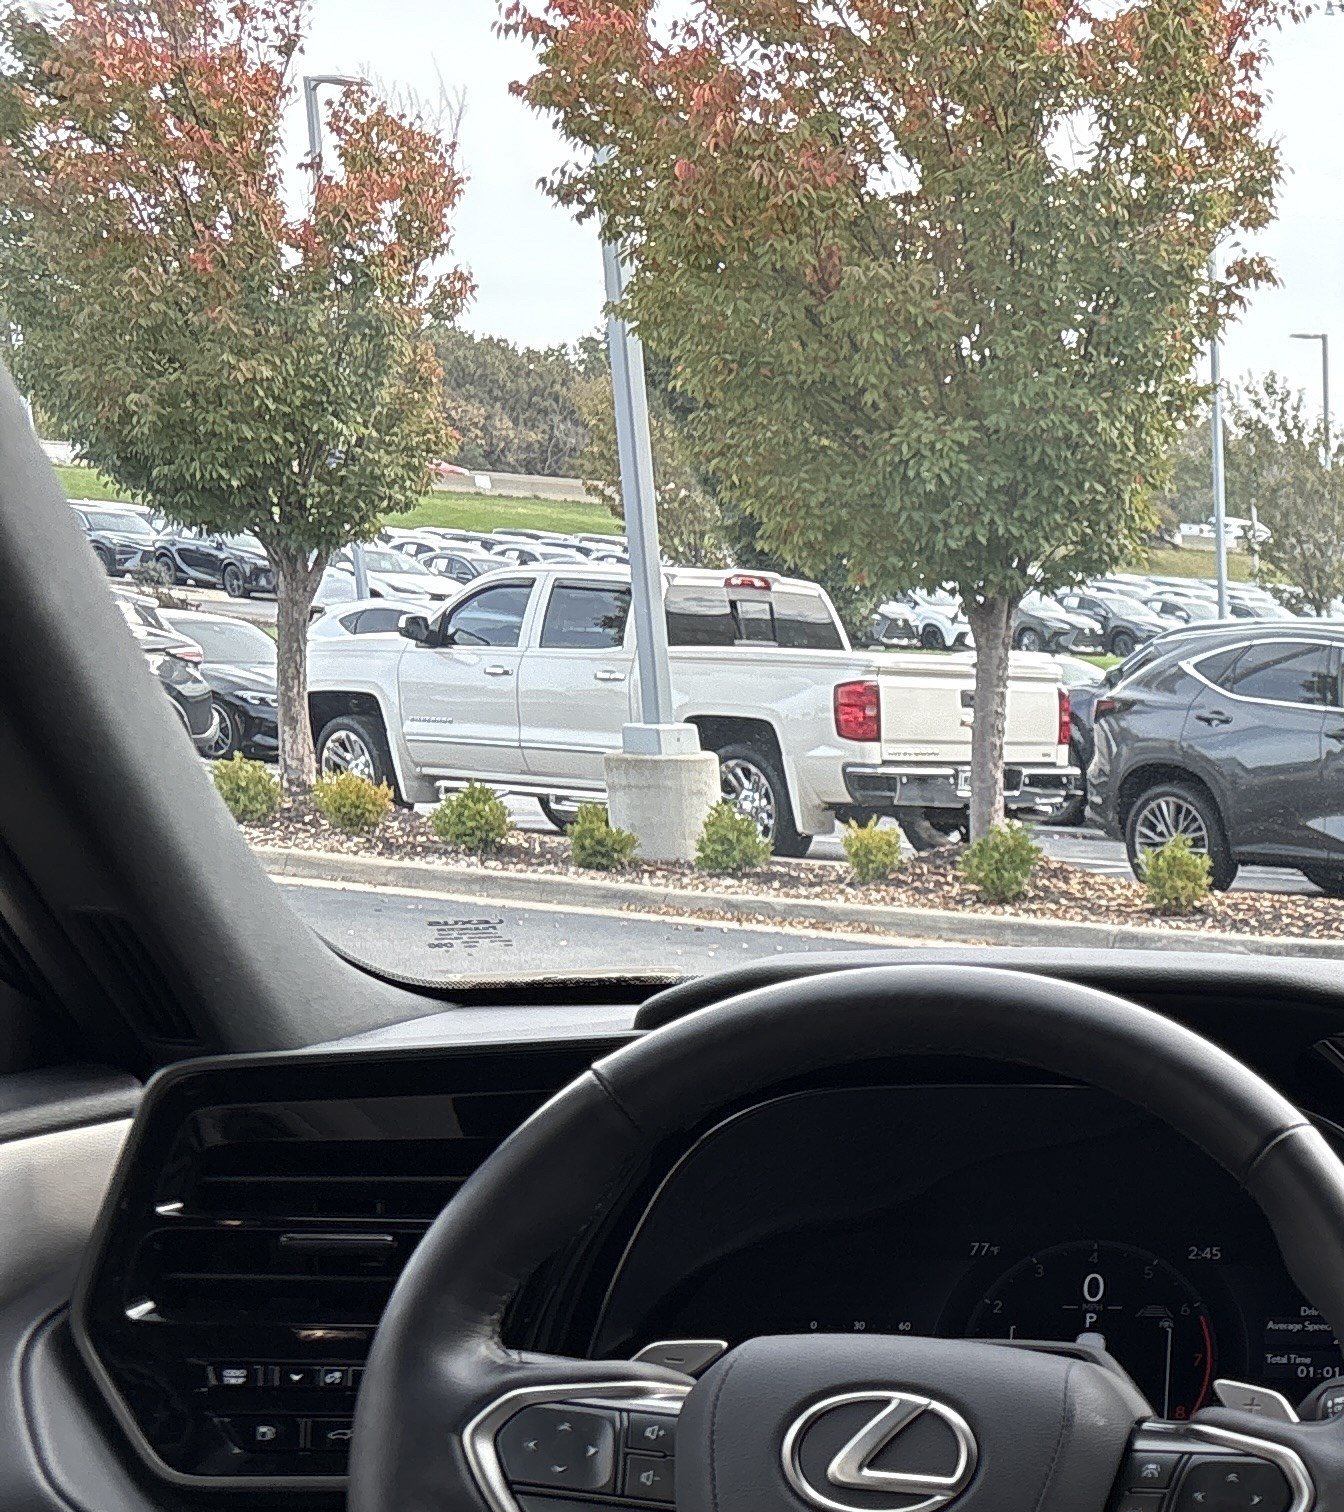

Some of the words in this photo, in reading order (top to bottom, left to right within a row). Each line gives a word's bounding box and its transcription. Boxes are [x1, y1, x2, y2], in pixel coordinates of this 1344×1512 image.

[1188, 1246, 1221, 1260] 2:45
[1035, 1265, 1044, 1277] 3
[1083, 1273, 1104, 1301] 0
[810, 1321, 818, 1329] 0
[854, 1321, 866, 1330] 30
[898, 1321, 911, 1331] 60
[1085, 1313, 1097, 1328] P
[1266, 1320, 1303, 1332] Average
[1265, 1354, 1288, 1364] Total
[1289, 1354, 1312, 1364] Time
[1297, 1366, 1340, 1378] 01:01
[1175, 1406, 1186, 1418] 8
